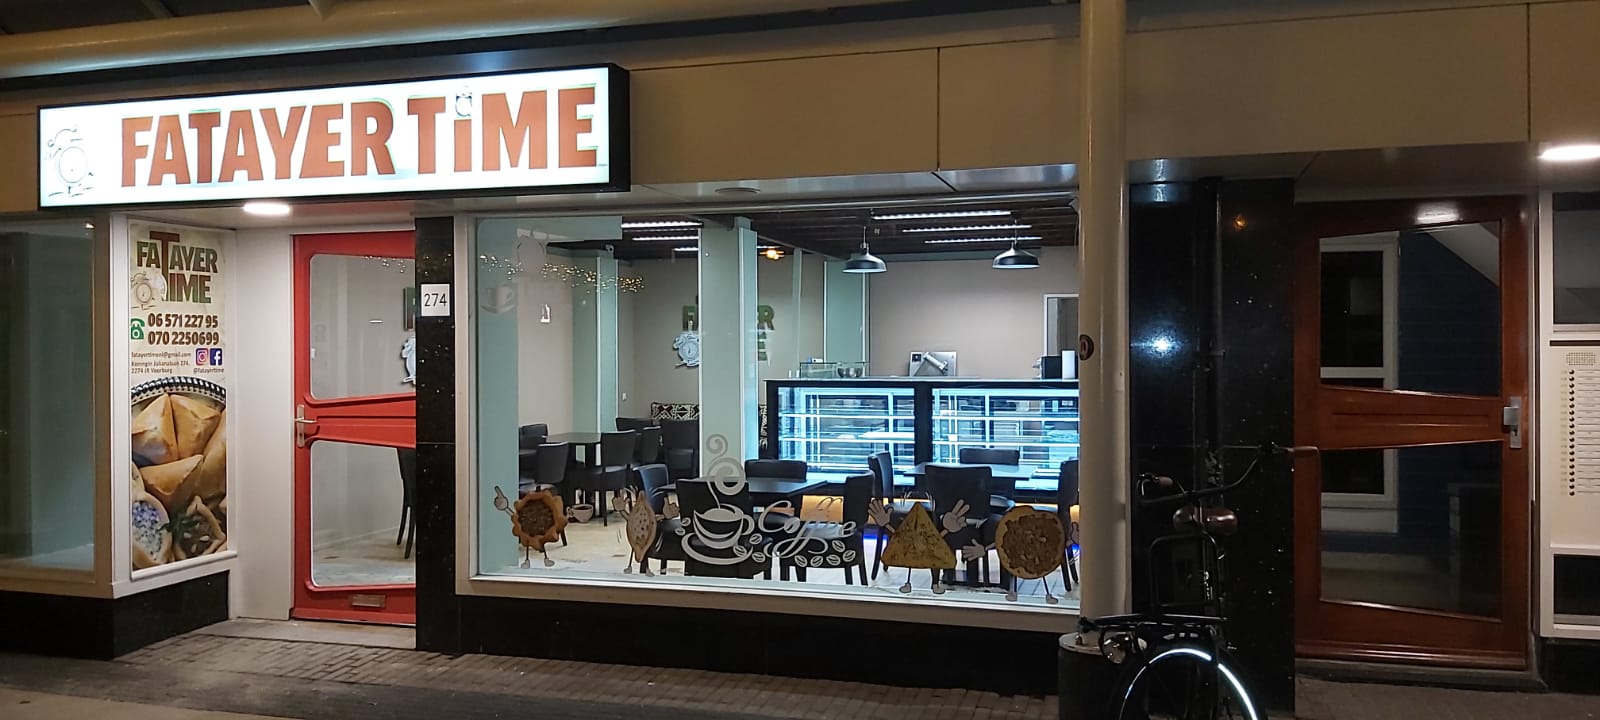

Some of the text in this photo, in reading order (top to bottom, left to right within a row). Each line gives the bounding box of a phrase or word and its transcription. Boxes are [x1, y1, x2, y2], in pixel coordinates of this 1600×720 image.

[121, 99, 395, 187] FATAYER
[424, 293, 447, 307] 274
[148, 313, 163, 327] 06
[205, 315, 218, 329] 95
[148, 331, 219, 346] 070 2250699
